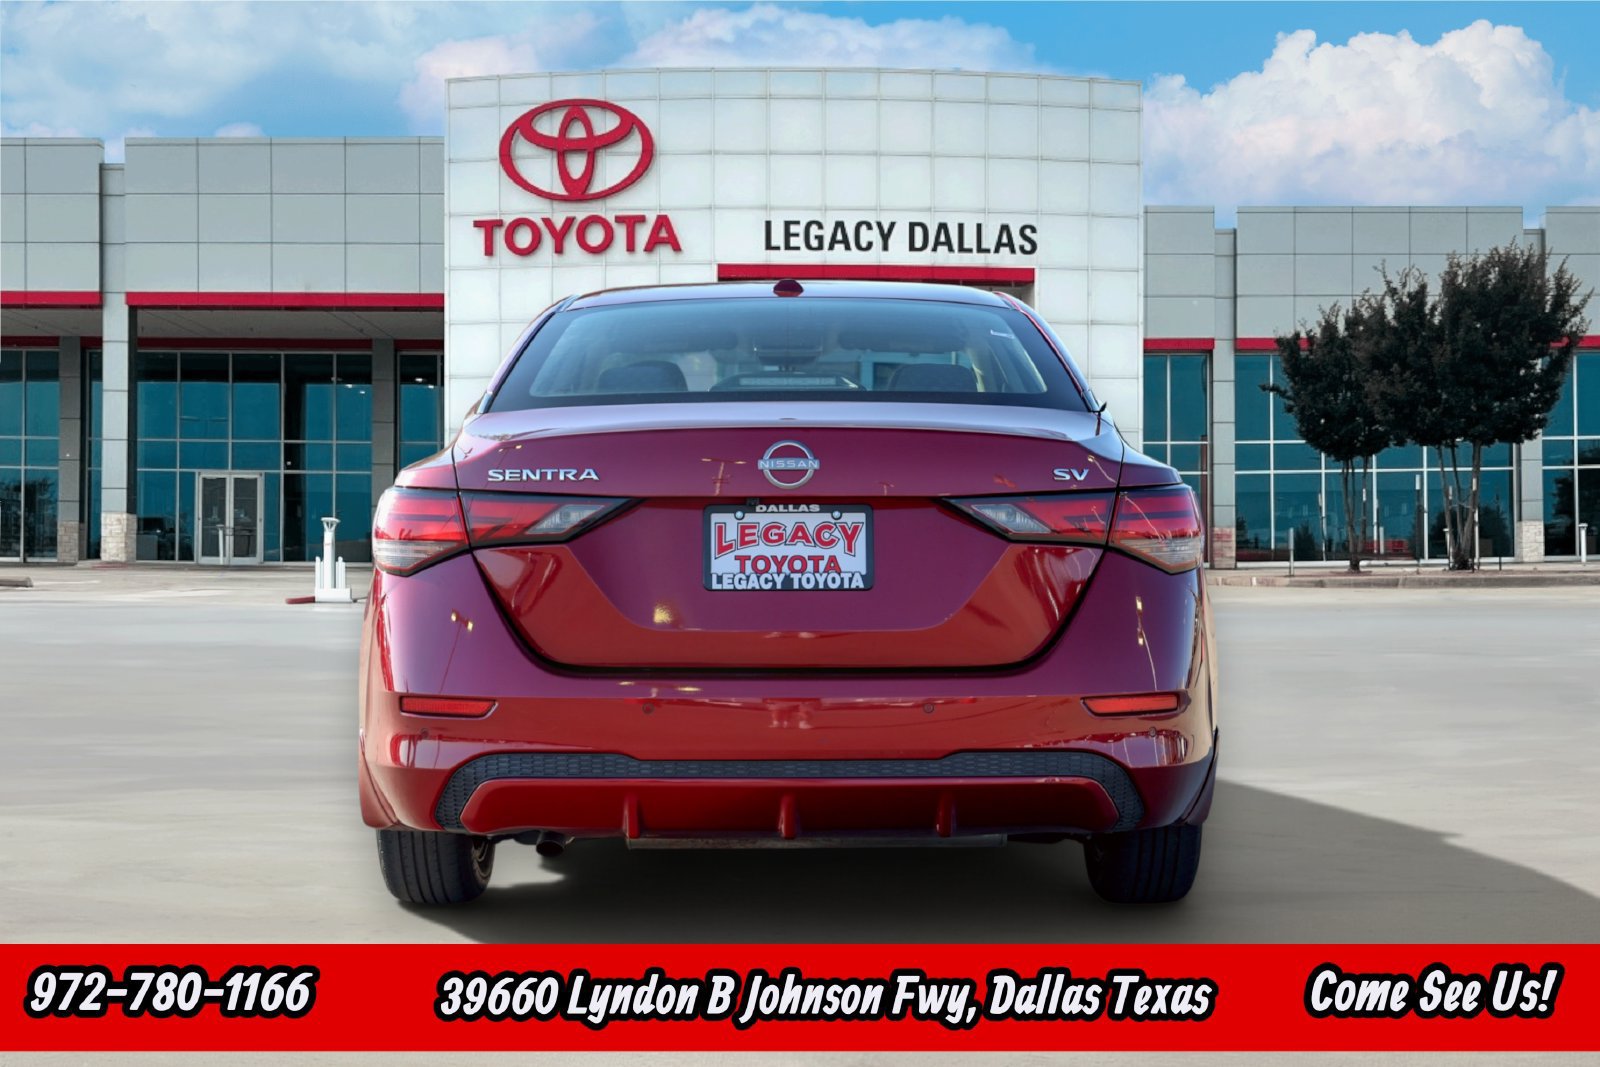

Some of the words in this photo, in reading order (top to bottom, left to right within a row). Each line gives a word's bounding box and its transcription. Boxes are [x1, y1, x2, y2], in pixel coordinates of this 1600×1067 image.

[474, 214, 681, 257] TOYOTA
[765, 220, 896, 252] LEGACY
[908, 221, 1038, 255] DALLAS
[759, 460, 819, 469] NISSAN
[1053, 467, 1089, 481] SV
[487, 468, 600, 482] SENTRA
[755, 504, 821, 513] DALLAS
[715, 522, 864, 559] LEGACY
[735, 555, 842, 574] TOYOTA
[711, 572, 785, 590] LEGACY
[790, 571, 865, 590] TOYOTA
